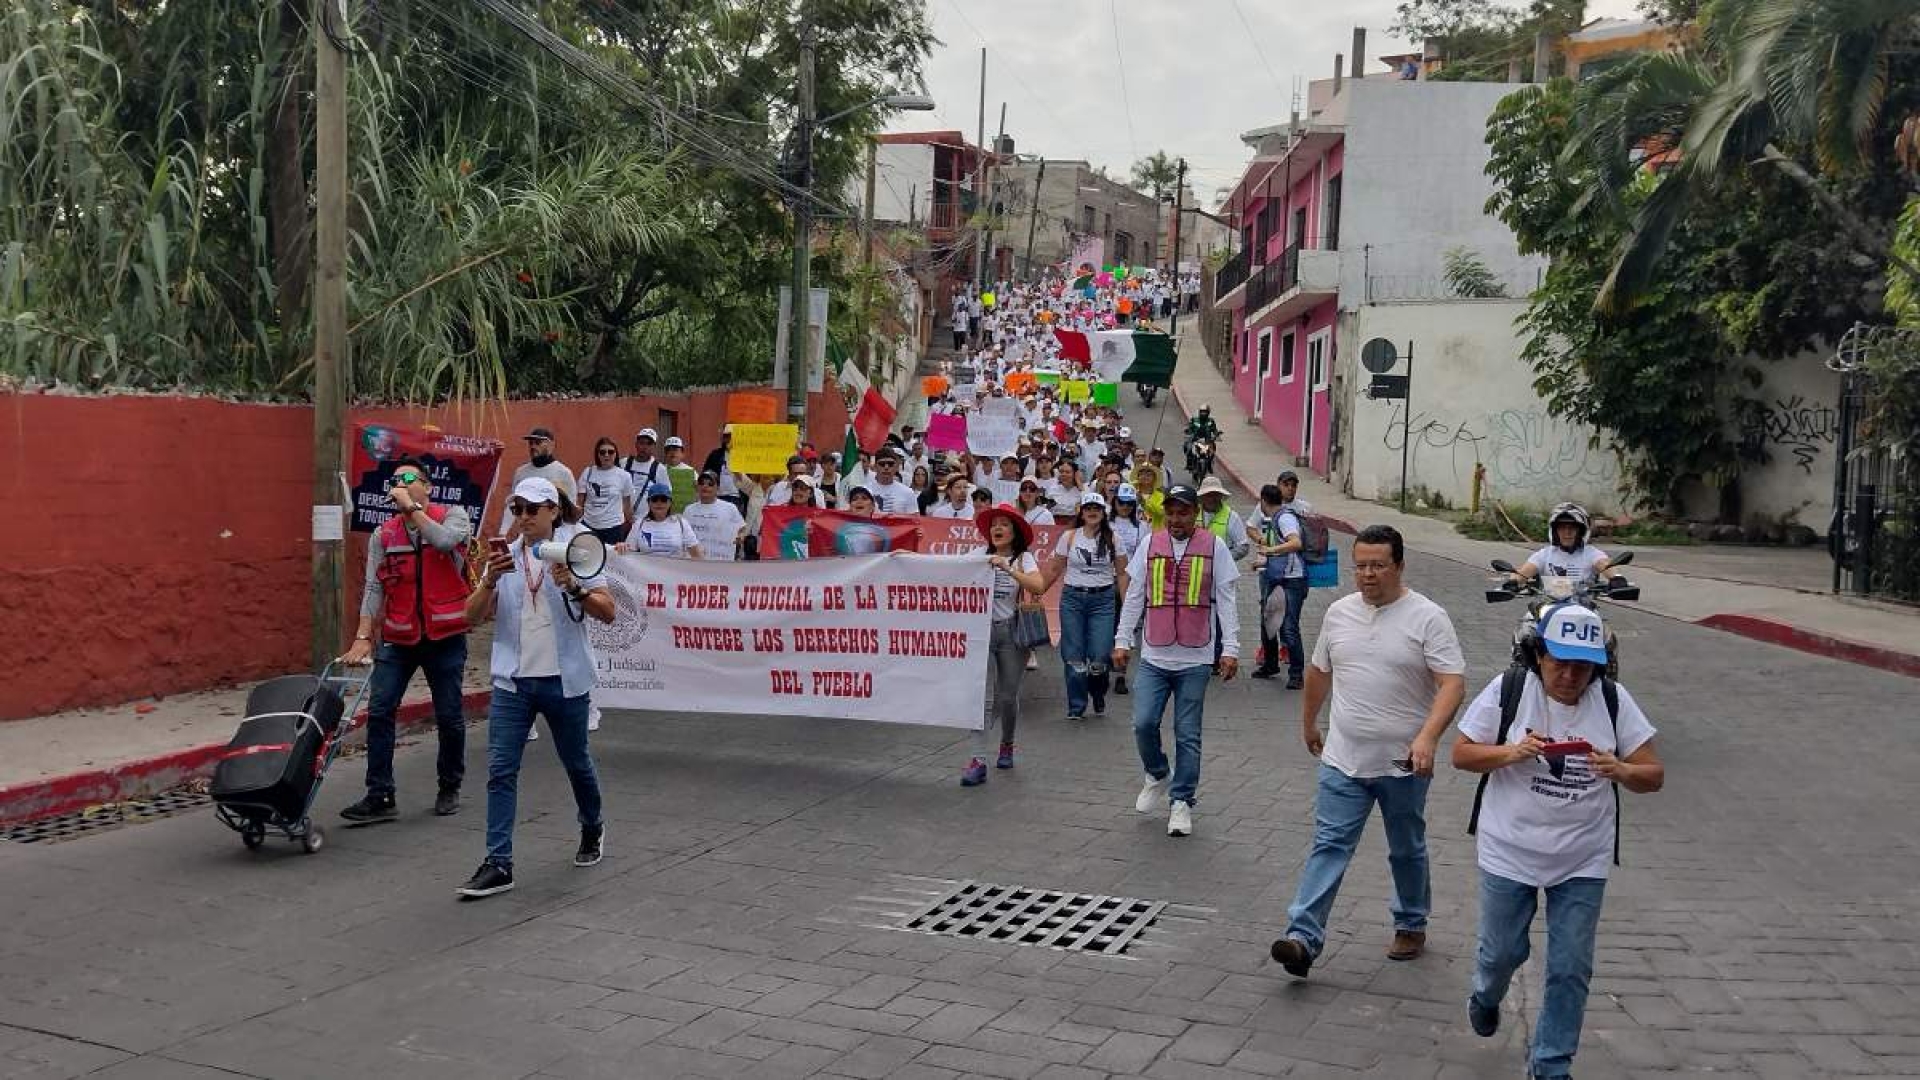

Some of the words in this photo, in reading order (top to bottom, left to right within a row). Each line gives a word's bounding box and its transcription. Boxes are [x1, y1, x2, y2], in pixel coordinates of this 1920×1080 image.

[442, 486, 462, 500] LOS
[646, 583, 666, 608] EL
[676, 585, 729, 609] PODER
[739, 586, 812, 611] JUDICIAL
[823, 586, 845, 610] DE
[854, 585, 877, 610] LA
[672, 625, 744, 652] PROTEGE
[752, 628, 783, 652] LOS
[793, 628, 879, 654] DERECHOS
[888, 629, 967, 658] HUMANOS
[1561, 621, 1601, 642] PJF
[605, 657, 656, 672] Judicial
[770, 669, 804, 694] DEL
[812, 671, 873, 698] PUEBLO
